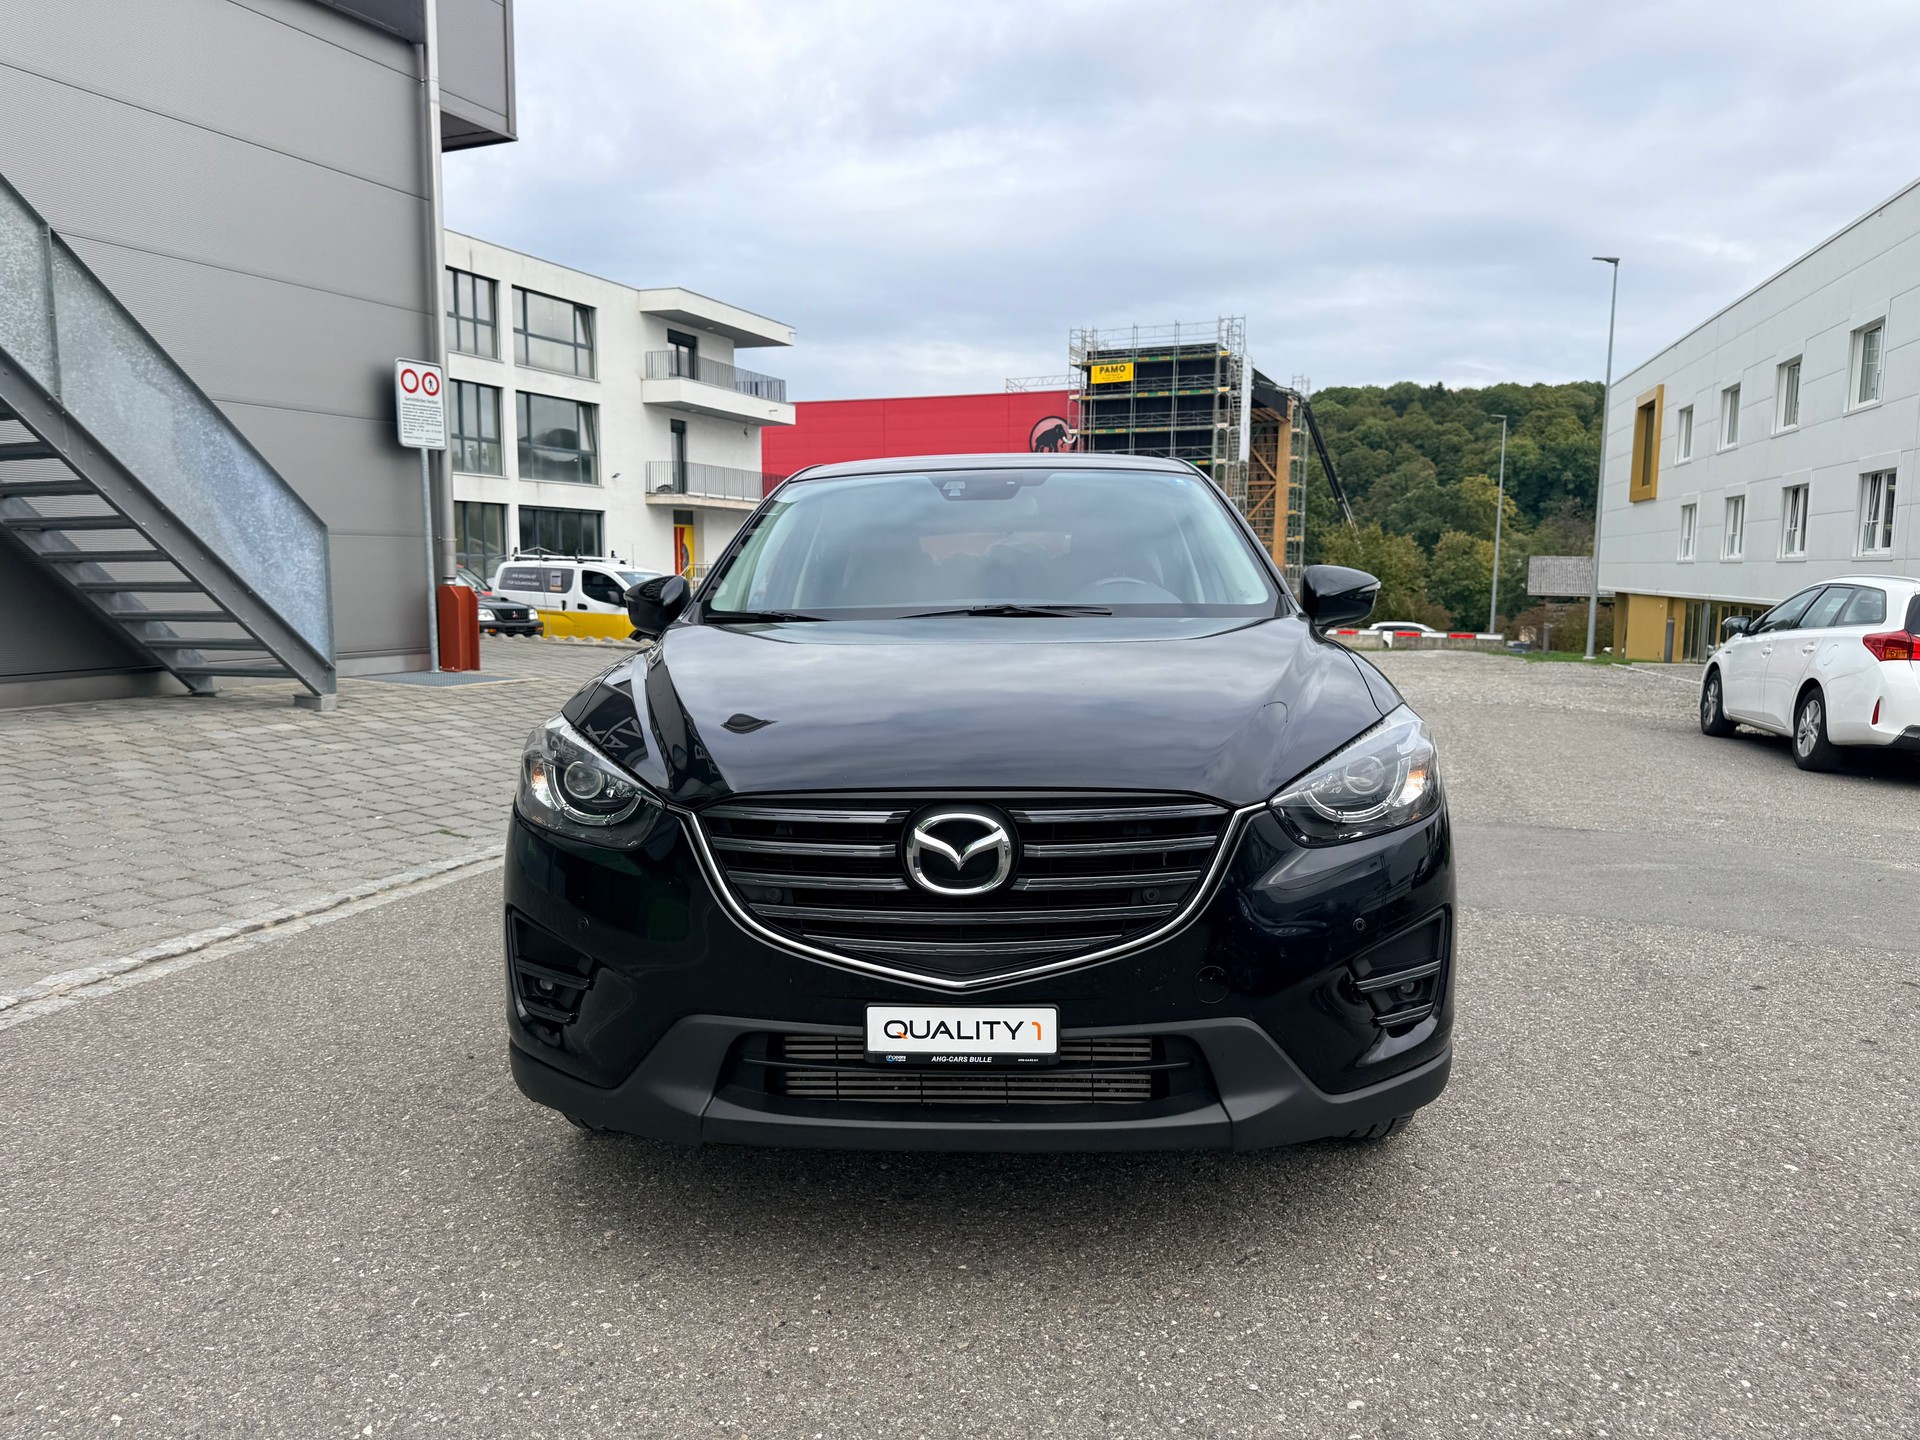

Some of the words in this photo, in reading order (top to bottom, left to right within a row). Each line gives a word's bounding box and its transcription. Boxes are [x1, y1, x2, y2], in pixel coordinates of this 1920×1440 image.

[1099, 364, 1126, 374] PAMO
[883, 1020, 1025, 1040] QUALITY
[1031, 1021, 1042, 1040] 1
